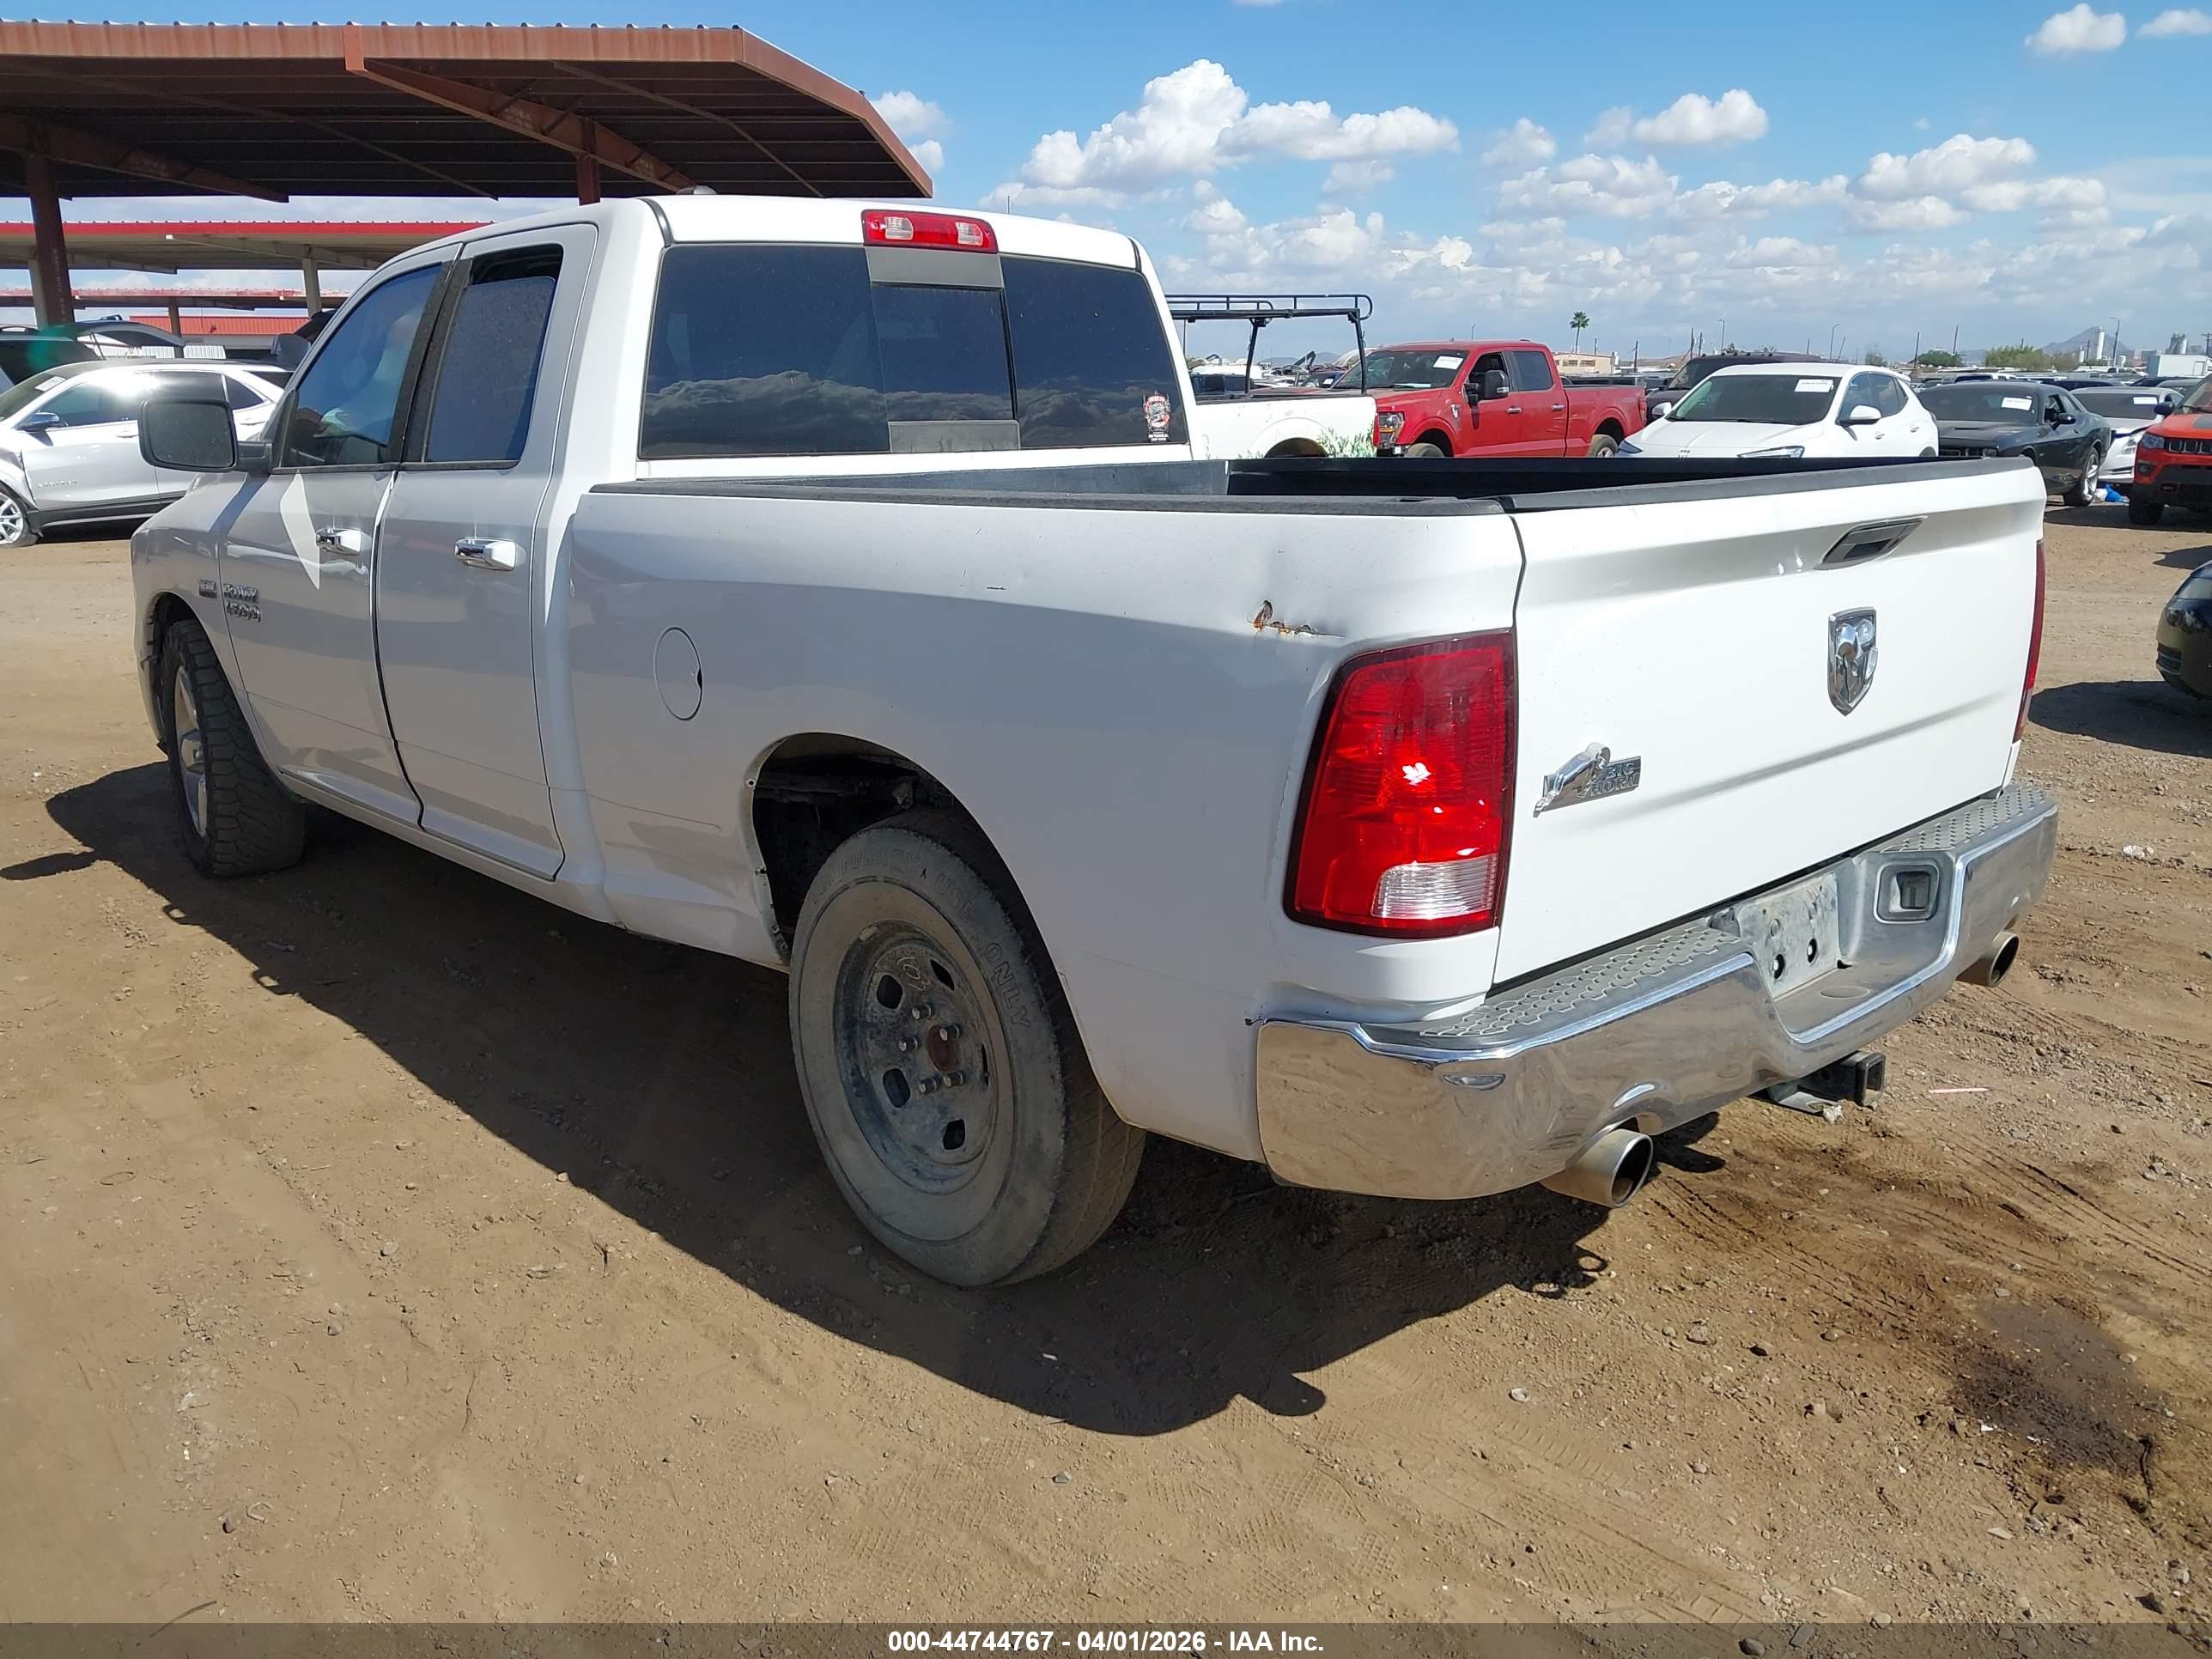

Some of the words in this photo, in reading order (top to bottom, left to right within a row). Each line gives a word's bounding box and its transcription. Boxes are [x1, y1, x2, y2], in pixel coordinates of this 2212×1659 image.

[1606, 762, 1636, 779] BIG
[1589, 775, 1640, 797] HORN
[934, 872, 977, 924] USE
[983, 942, 1032, 1029] ONLY
